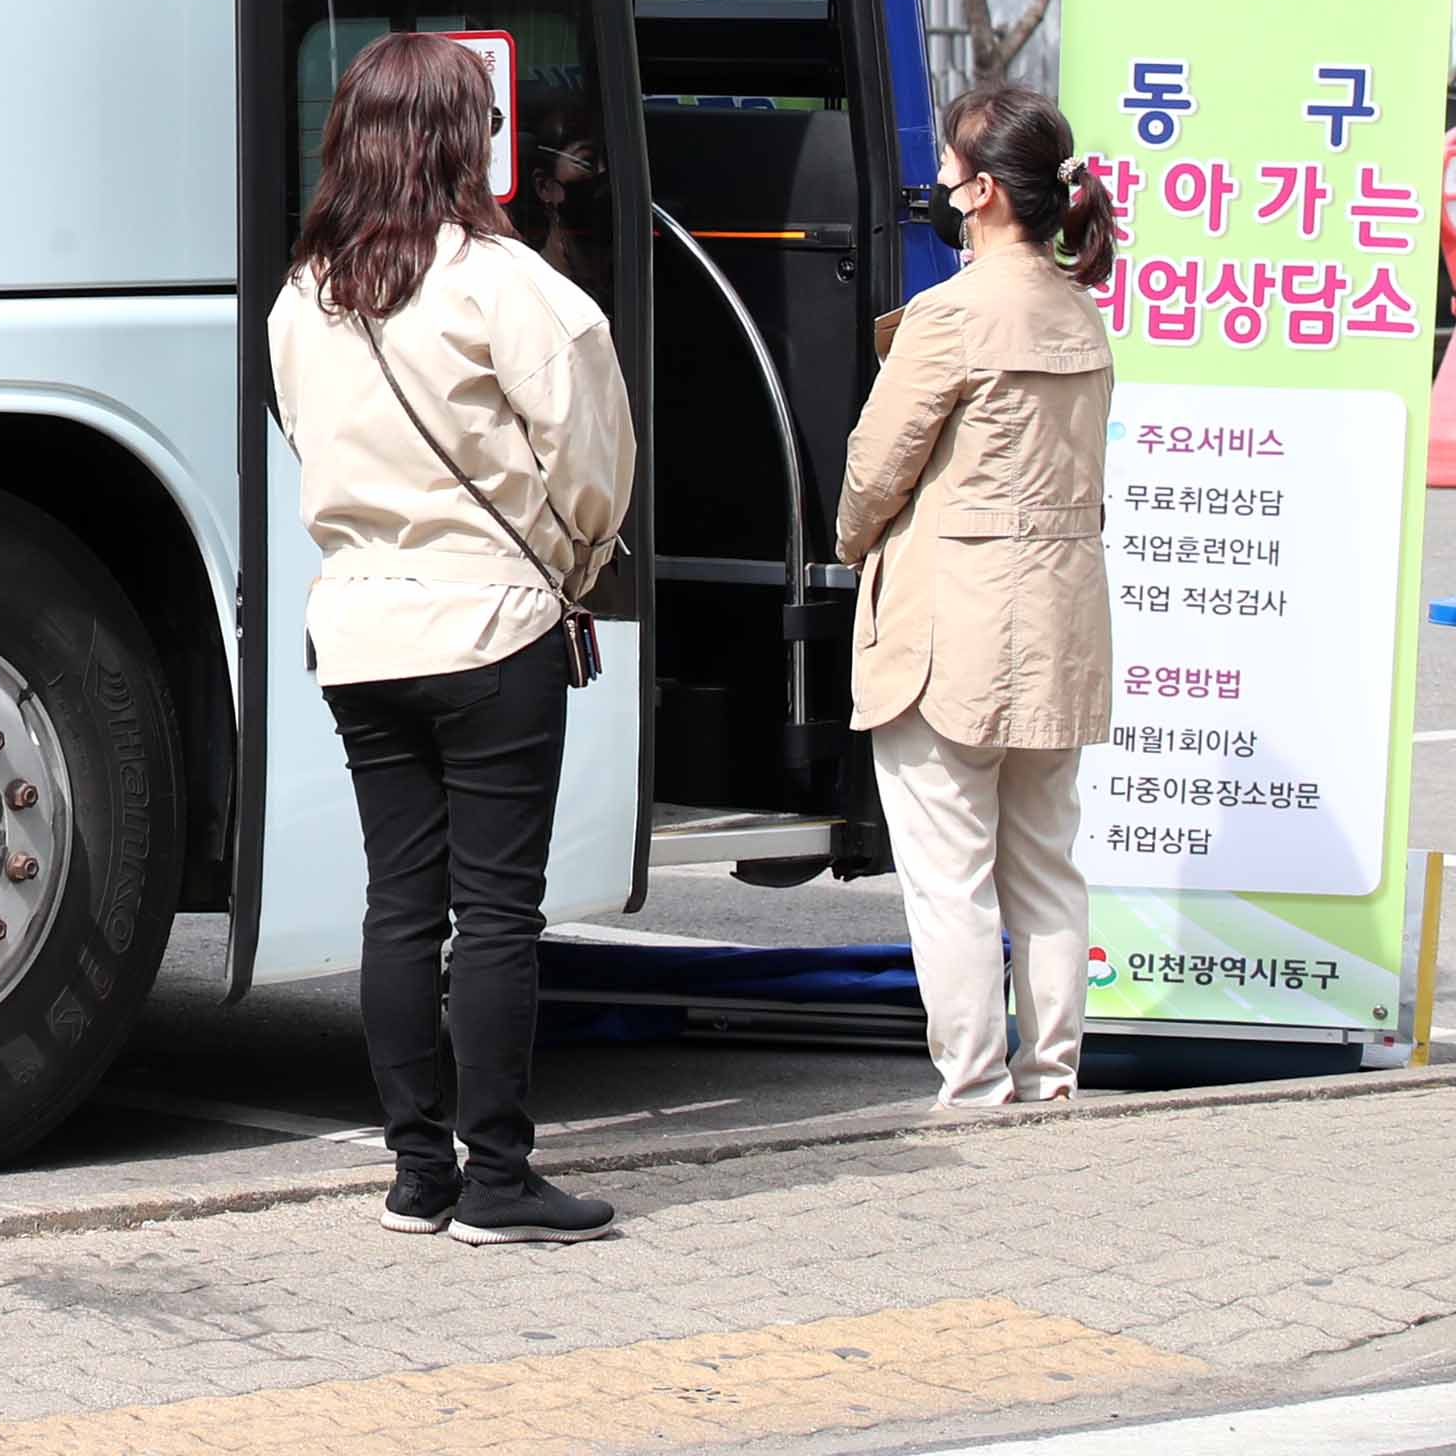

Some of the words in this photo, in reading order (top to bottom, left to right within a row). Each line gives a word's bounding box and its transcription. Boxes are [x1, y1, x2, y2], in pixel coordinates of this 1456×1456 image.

[1136, 424, 1286, 457] 주요서비스
[1124, 484, 1285, 516] 무료취업상담
[1122, 535, 1280, 567] 직업훈련안내
[1120, 585, 1170, 613] 직업
[1182, 587, 1287, 617] 적성검사
[1123, 665, 1242, 700] 운영방법
[1112, 725, 1258, 758] 매월1회이상
[1109, 775, 1322, 810] 다중이용장소방문
[1106, 824, 1213, 856] 취업상담
[1127, 952, 1341, 991] 인천광역시동구
